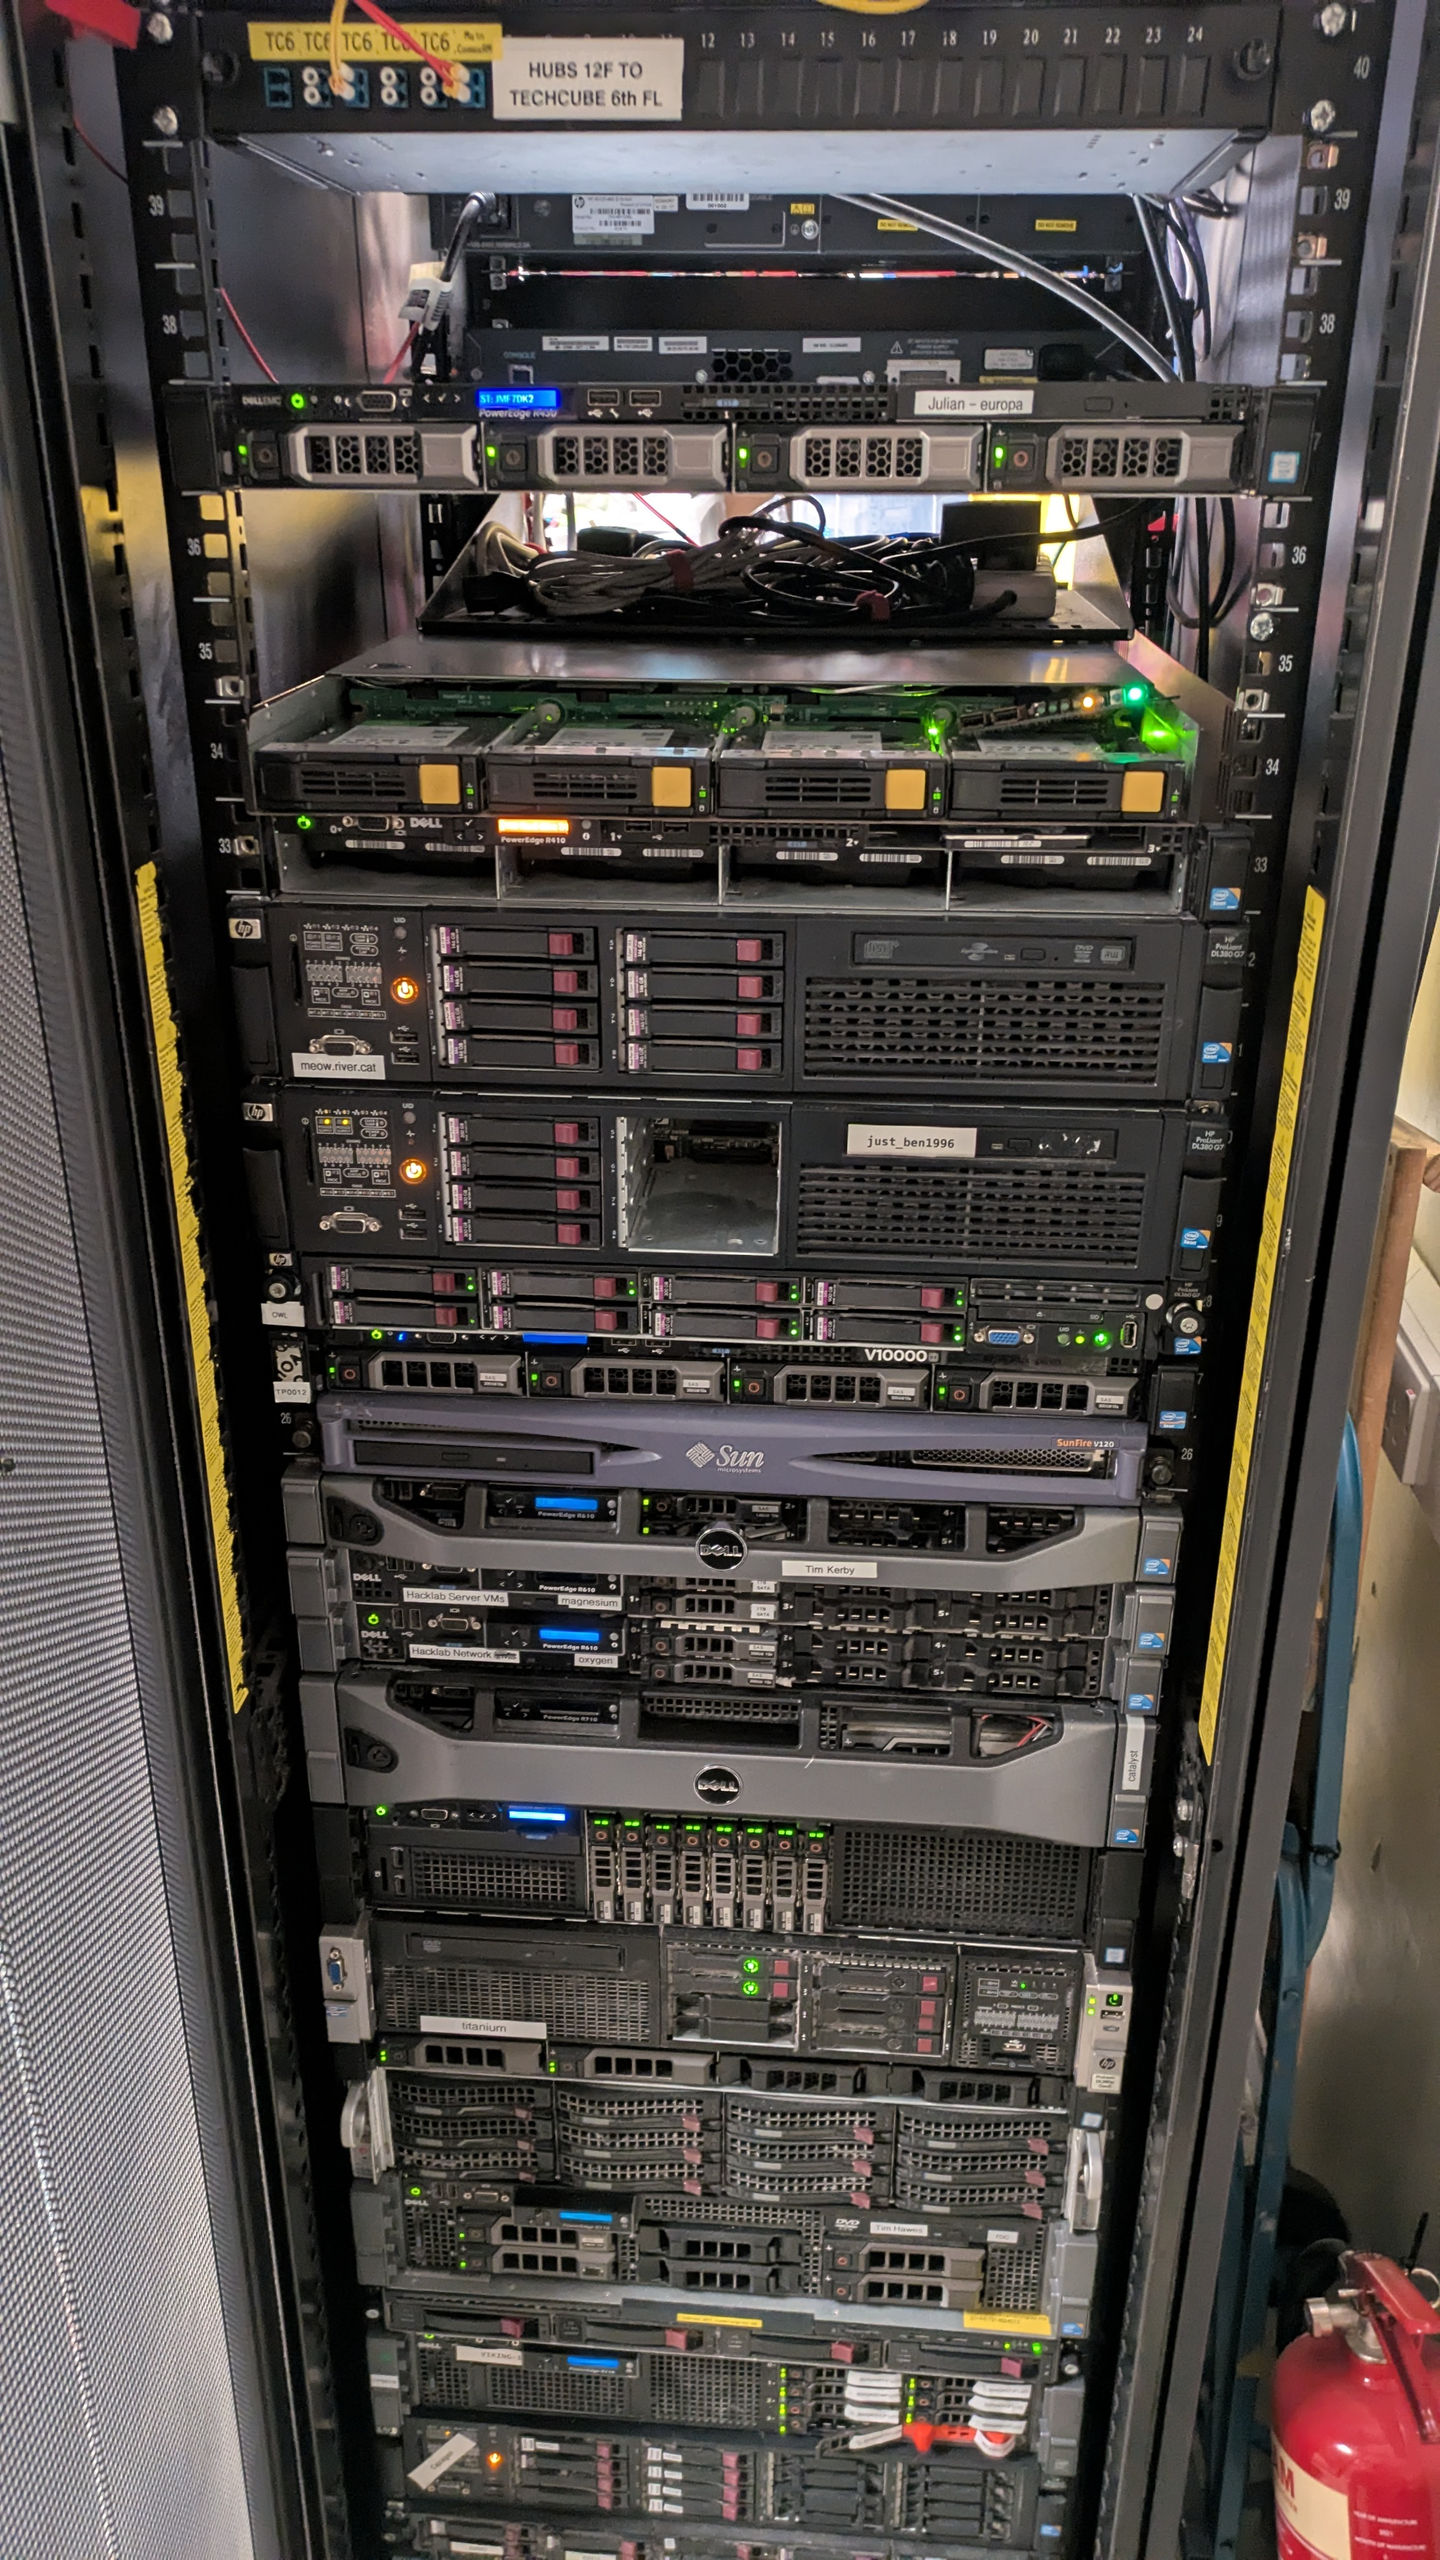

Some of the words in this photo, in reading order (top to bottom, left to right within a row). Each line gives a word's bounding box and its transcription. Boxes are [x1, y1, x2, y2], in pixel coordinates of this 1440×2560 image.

[265, 31, 294, 50] TC6
[342, 31, 372, 50] TC6
[421, 31, 450, 50] TC6
[702, 32, 715, 48] 12
[740, 32, 755, 48] 13
[781, 32, 795, 47] 14
[821, 31, 835, 47] 15
[862, 32, 876, 47] 16
[902, 30, 916, 46] 17
[942, 30, 957, 46] 18
[982, 29, 997, 45] 19
[1023, 28, 1039, 45] 20
[1063, 27, 1077, 44] 21
[1105, 27, 1120, 43] 22
[1145, 26, 1161, 43] 23
[1187, 26, 1203, 42] 24
[528, 62, 578, 78] HUBS
[584, 62, 614, 78] 12F
[617, 62, 643, 78] TO
[1353, 55, 1370, 79] 40
[510, 90, 605, 106] TECHCUBE
[611, 90, 637, 106] 6th
[642, 90, 662, 106] FL
[149, 194, 164, 217] 39
[1334, 188, 1351, 210] 39
[162, 315, 178, 334] 38
[1319, 313, 1336, 334] 38
[928, 397, 966, 412] Julian
[980, 398, 1023, 415] europa
[479, 409, 531, 420] PowerEdge
[187, 539, 201, 556] 36
[1292, 546, 1307, 565] 36
[198, 642, 213, 660] 35
[1278, 655, 1293, 673] 35
[210, 742, 223, 758] 34
[1265, 759, 1280, 775] 34
[410, 816, 443, 829] DELL
[218, 837, 231, 853] 33
[501, 836, 544, 844] PowerEdge
[546, 836, 566, 844] R410
[1254, 856, 1268, 873] 33
[300, 1061, 377, 1074] meow.river.cat
[867, 1135, 955, 1149] just_ben1996
[1196, 1136, 1222, 1144] ProLiant
[272, 1311, 288, 1319] OWL
[864, 1349, 928, 1362] V10000
[280, 1412, 292, 1424] 26
[1057, 1438, 1092, 1447] SunFire
[716, 1445, 765, 1468] Sun
[1181, 1447, 1193, 1460] 26
[538, 1511, 575, 1519] PowerEdge
[700, 1543, 743, 1557] DELL
[805, 1564, 824, 1575] Tim
[827, 1565, 855, 1576] Kerby
[353, 1573, 381, 1582] DELL
[539, 1584, 577, 1592] PowerEdge
[406, 1591, 446, 1600] Hacklab
[449, 1592, 480, 1601] Server
[484, 1594, 505, 1603] VMs
[561, 1597, 618, 1608] magnesium
[361, 1630, 389, 1639] DELL
[412, 1647, 450, 1657] Hacklab
[453, 1649, 491, 1659] Network
[543, 1643, 580, 1651] PowerEdge
[578, 1657, 613, 1666] oxygen
[543, 1714, 580, 1722] PowerEdge
[1128, 1749, 1138, 1782] catalyst
[462, 2021, 507, 2033] titanium
[875, 2224, 891, 2232] Tim
